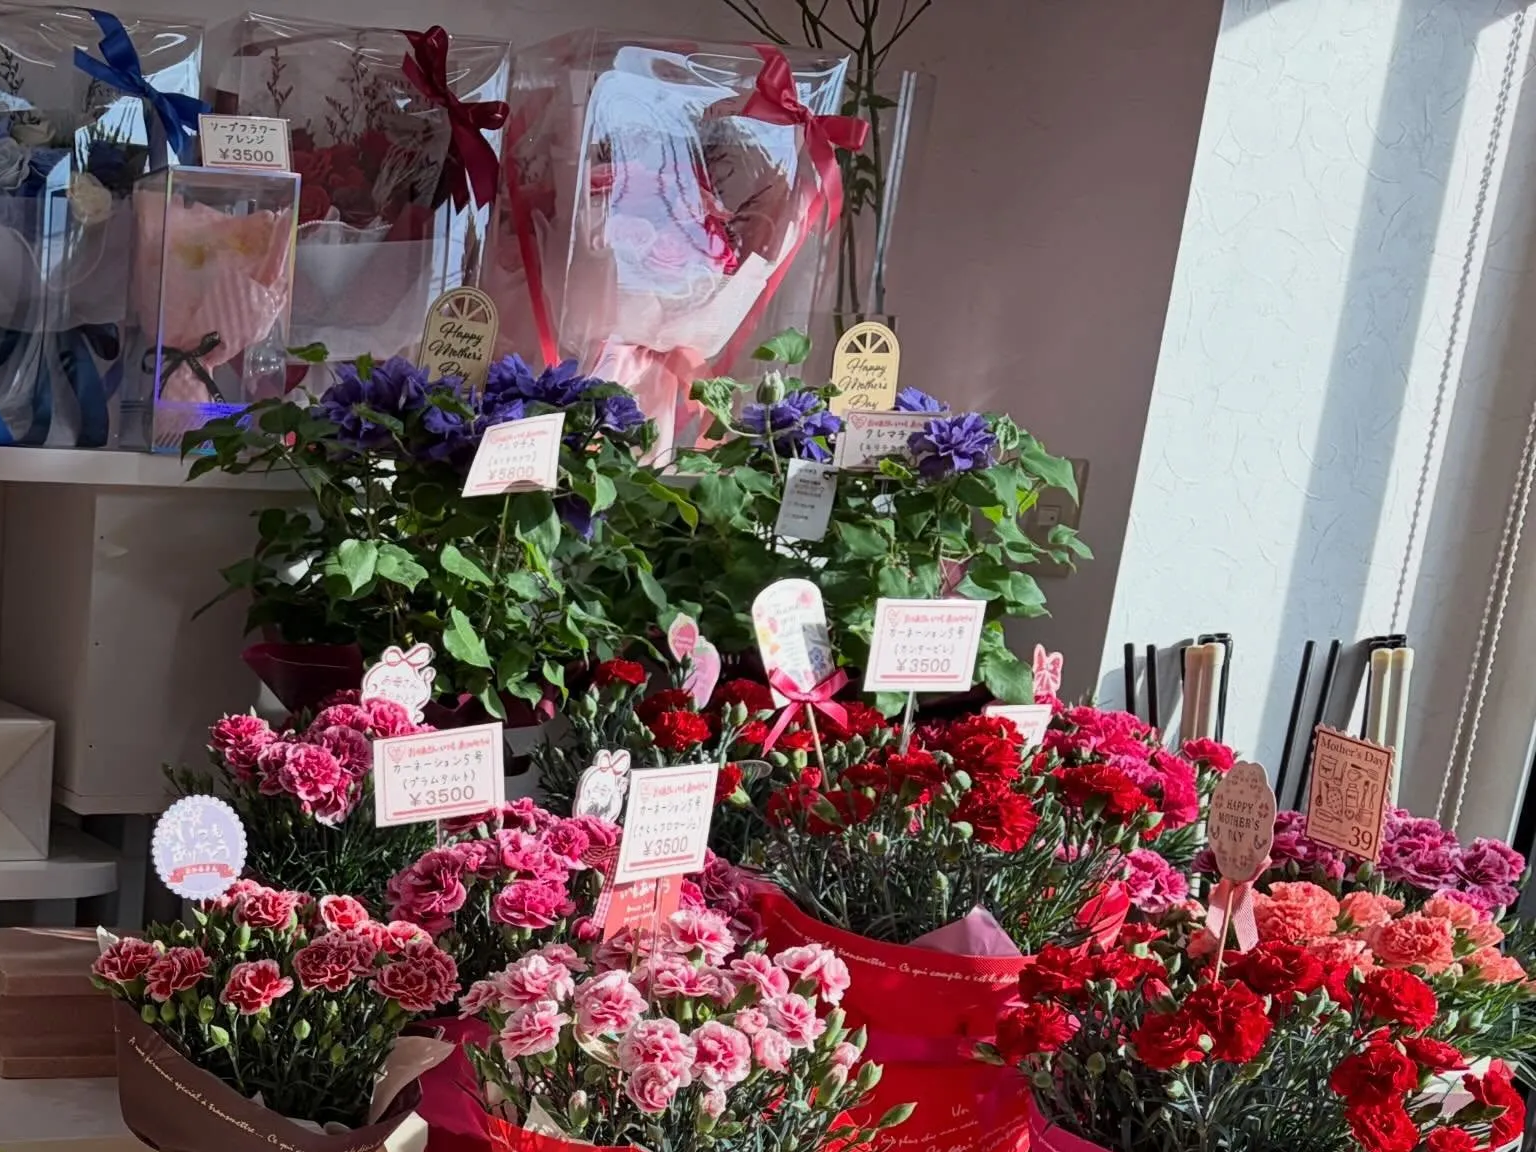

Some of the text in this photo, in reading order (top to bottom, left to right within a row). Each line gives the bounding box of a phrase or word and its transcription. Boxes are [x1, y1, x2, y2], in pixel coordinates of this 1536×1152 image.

[226, 135, 264, 144] アレンジ
[219, 148, 273, 162] ¥3500
[440, 322, 484, 349] Happy
[438, 362, 471, 383] Day
[847, 358, 887, 375] Happy
[849, 394, 879, 409] Day
[896, 659, 950, 672] ¥3500
[1321, 736, 1385, 768] Mother's Day
[394, 751, 485, 774] カーネーション5号
[409, 786, 474, 806] ¥3500
[1227, 800, 1254, 815] HAPPY
[1219, 813, 1260, 831] MOTHER'S
[643, 836, 688, 856] ¥3500
[1349, 827, 1372, 851] 39
[268, 1134, 278, 1145] Ce
